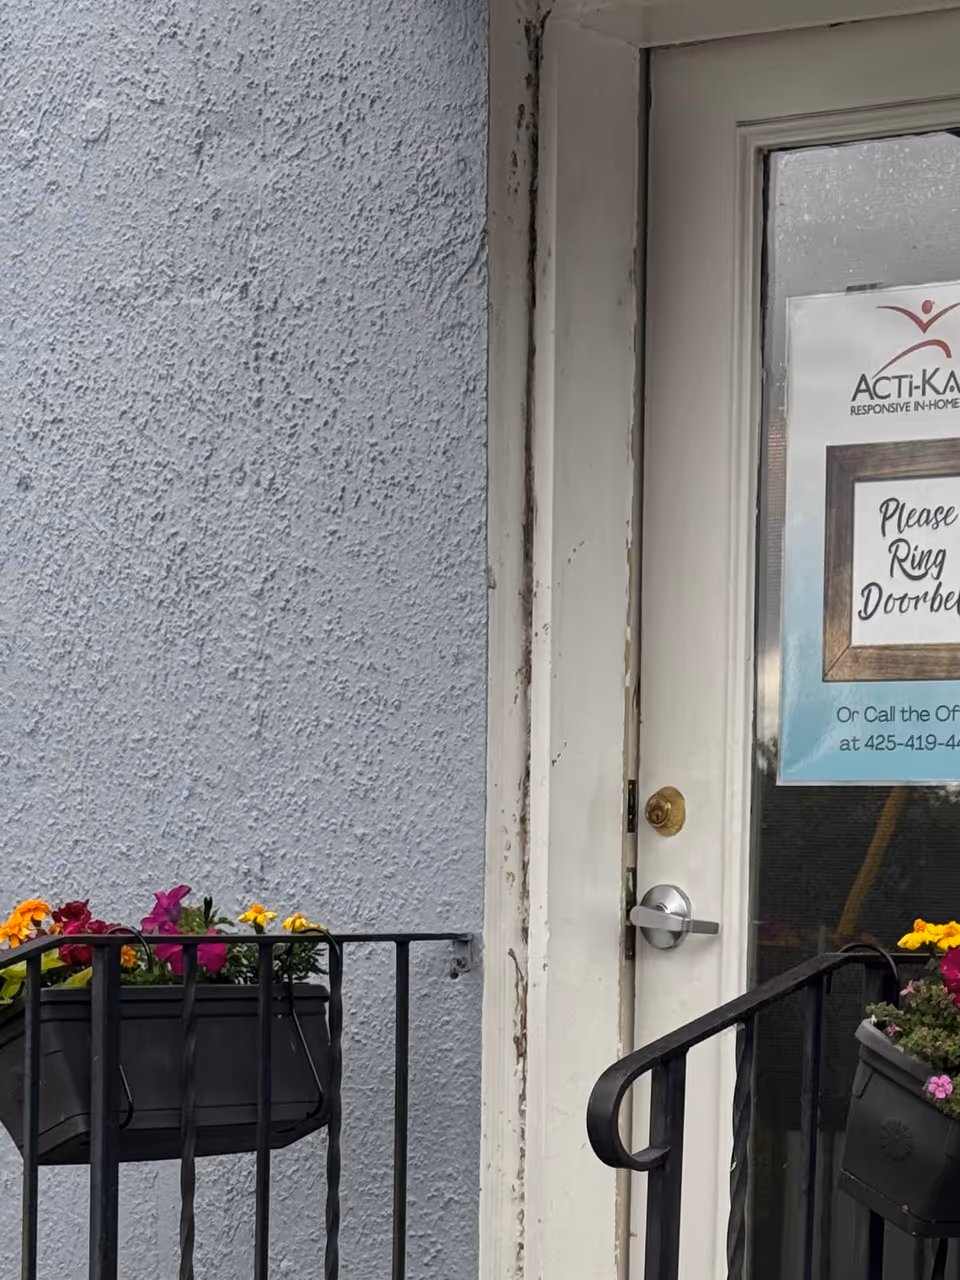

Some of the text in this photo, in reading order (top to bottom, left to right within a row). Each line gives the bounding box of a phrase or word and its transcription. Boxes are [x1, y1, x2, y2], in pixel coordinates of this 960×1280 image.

[850, 401, 911, 416] RESPONSIVE
[914, 397, 960, 412] IN-HOME
[879, 497, 959, 538] Please
[887, 537, 947, 580] Ring
[836, 705, 860, 723] Or
[863, 705, 897, 722] Call
[899, 705, 931, 722] the
[839, 737, 860, 752] at
